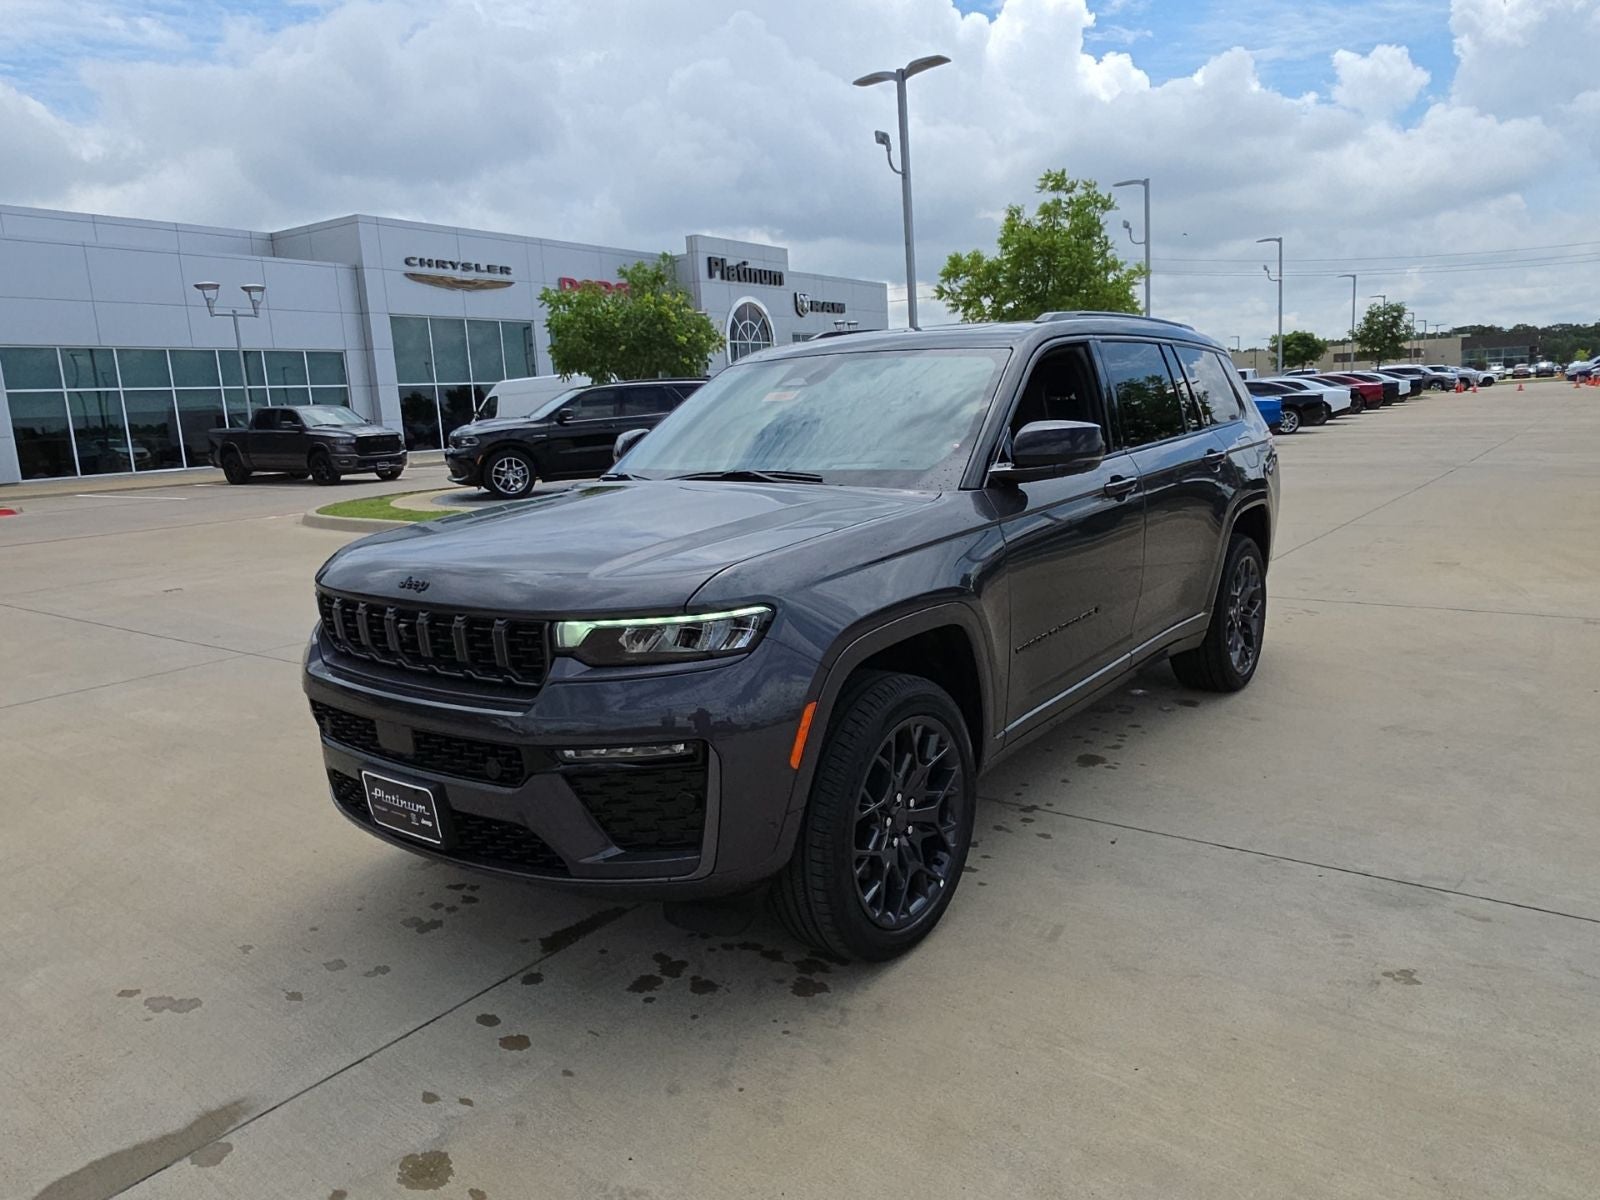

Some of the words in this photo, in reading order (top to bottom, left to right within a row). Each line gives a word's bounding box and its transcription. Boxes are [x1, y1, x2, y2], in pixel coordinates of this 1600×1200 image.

[404, 256, 512, 275] CHRYSLER
[707, 256, 784, 286] Platinum
[810, 300, 846, 314] RAM
[371, 788, 430, 816] Platinum
